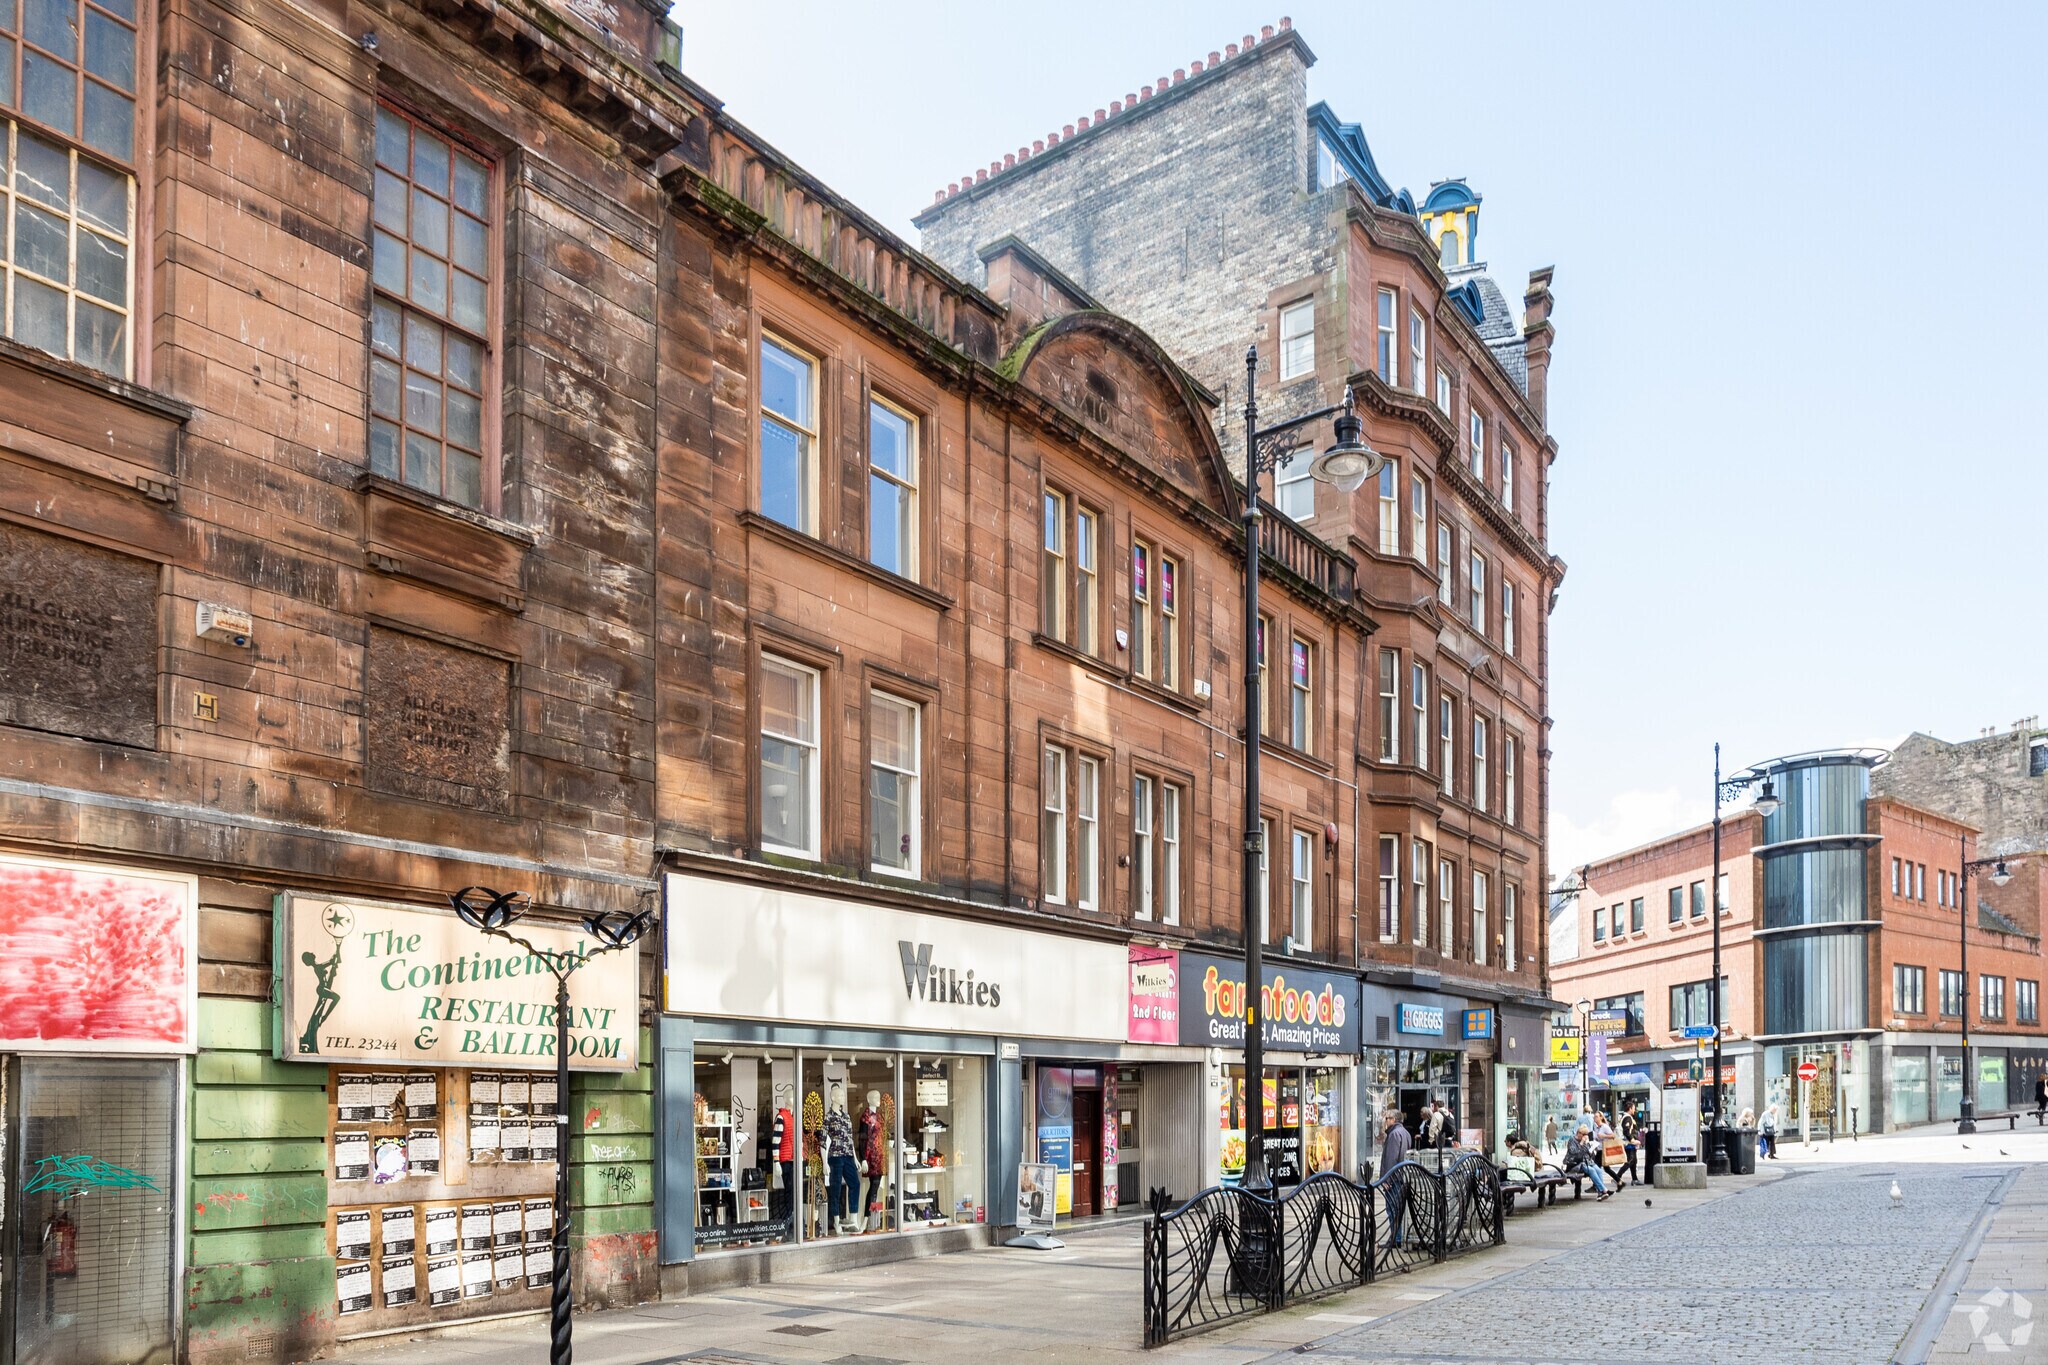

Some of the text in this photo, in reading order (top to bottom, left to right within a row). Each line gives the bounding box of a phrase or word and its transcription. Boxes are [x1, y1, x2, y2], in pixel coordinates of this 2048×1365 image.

[363, 929, 422, 959] The
[380, 938, 588, 992] Continental
[898, 940, 1001, 1008] Wilkies
[1137, 974, 1167, 987] Wilkies
[418, 995, 616, 1031] RESTAURANT
[1133, 1003, 1176, 1021] 2nd Floor
[1412, 1010, 1443, 1030] GREGGS
[414, 1025, 622, 1059] & BALLROOM
[1209, 1018, 1240, 1040] Great
[1271, 1023, 1312, 1047] Amazing
[1313, 1027, 1340, 1046] Prices
[1552, 1029, 1579, 1037] TO LET
[325, 1036, 398, 1051] TEL. 23244
[1040, 1127, 1069, 1137] SOLICITORS
[1270, 1166, 1291, 1179] PICES
[709, 1229, 727, 1237] online
[732, 1222, 786, 1234] www.wilkies.co.uk
